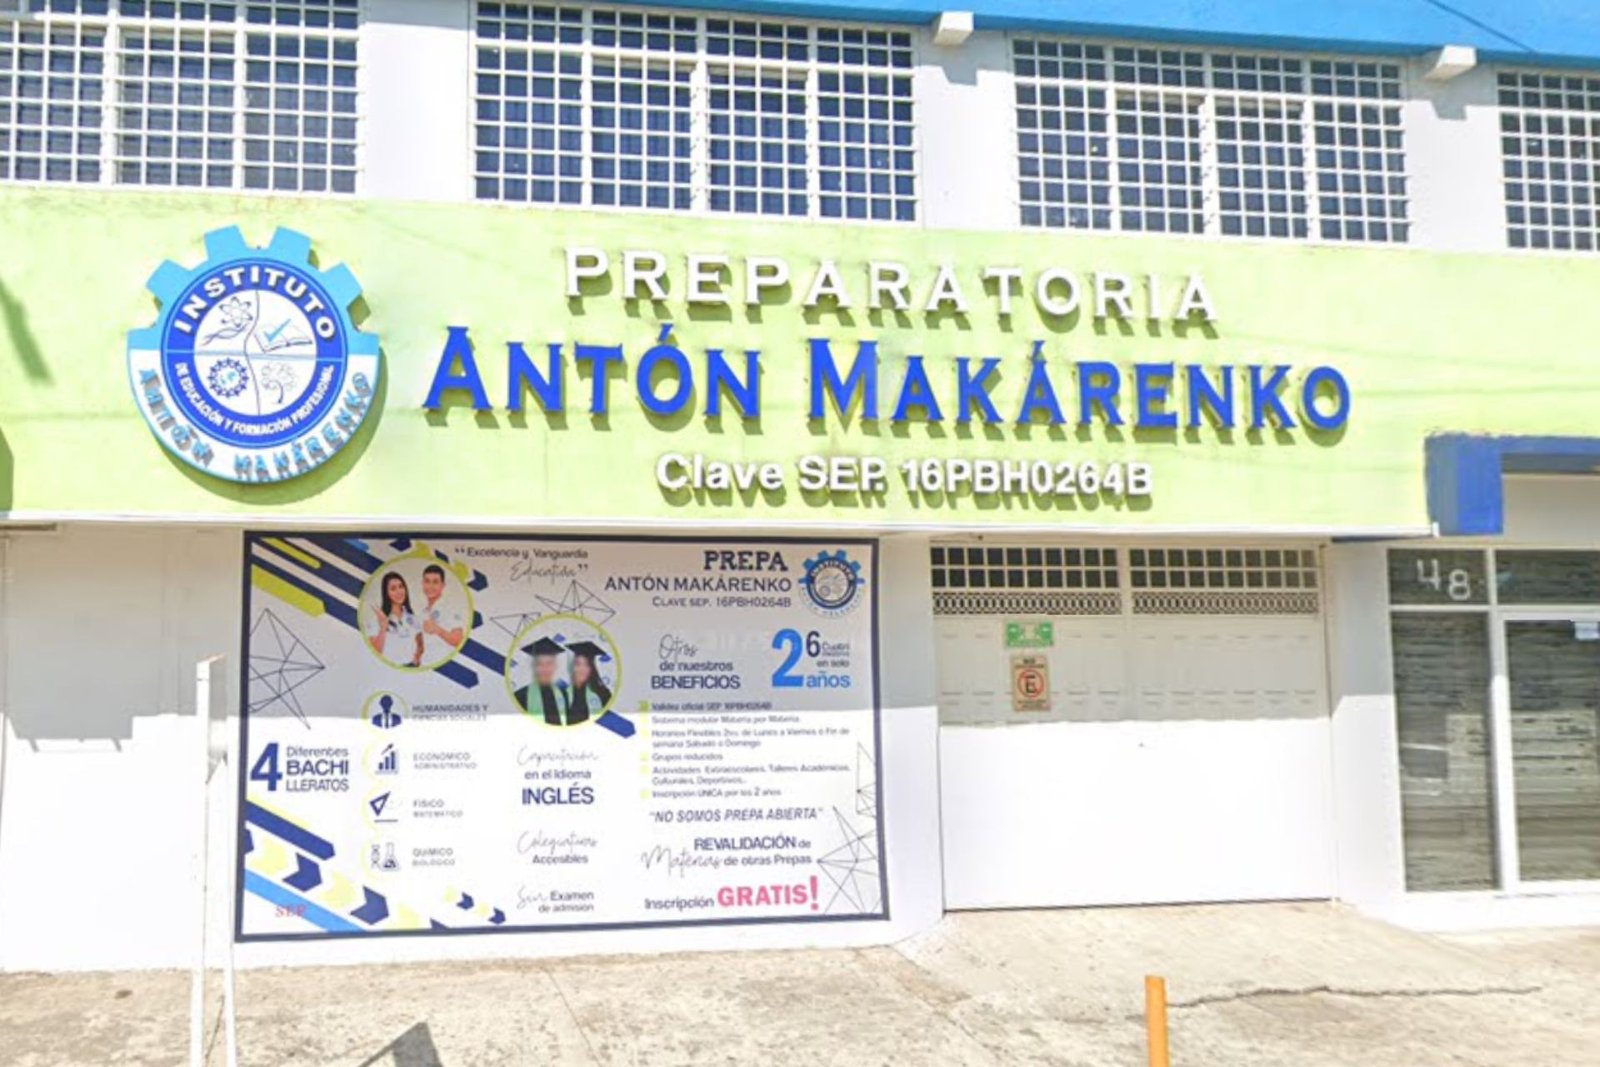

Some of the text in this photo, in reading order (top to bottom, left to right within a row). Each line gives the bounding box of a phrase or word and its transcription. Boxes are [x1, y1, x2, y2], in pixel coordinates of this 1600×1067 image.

[565, 247, 1217, 320] PREPARATORIA
[174, 265, 336, 339] INSTITUTO
[422, 323, 1351, 430] ANTÓN MAKÁRENKO
[656, 453, 1153, 495] Clave SEP. 16PBH0264B
[522, 549, 529, 560] y
[533, 548, 588, 560] Vanguardia
[703, 551, 788, 571] PREPA
[604, 573, 792, 592] ANTÓN MAKÁRENKO
[1416, 558, 1471, 600] 48
[716, 596, 792, 608] 16PBH0264B
[806, 630, 820, 658] 6
[659, 660, 734, 672] de nuestros
[771, 628, 804, 688] 2
[816, 660, 829, 668] en
[651, 674, 741, 690] BENEFICIOS
[806, 670, 851, 688] años
[412, 703, 480, 712] HUMANIDADES
[286, 746, 349, 757] Diferentes
[250, 743, 283, 792] 4
[286, 760, 349, 776] BACHI
[524, 770, 539, 780] en
[541, 769, 552, 780] el
[286, 778, 350, 792] LLERATOS
[754, 786, 760, 797] 2
[522, 781, 596, 806] INGLÉS
[676, 810, 721, 822] SOMOS
[724, 808, 764, 821] PREPA
[694, 832, 811, 851] REVALIDACIÓN de
[532, 854, 589, 865] Accesibles
[724, 856, 739, 866] de
[774, 854, 812, 867] Prepas
[550, 889, 594, 901] Examen
[645, 875, 819, 912] Inscripción GRATIS!
[538, 904, 551, 914] de
